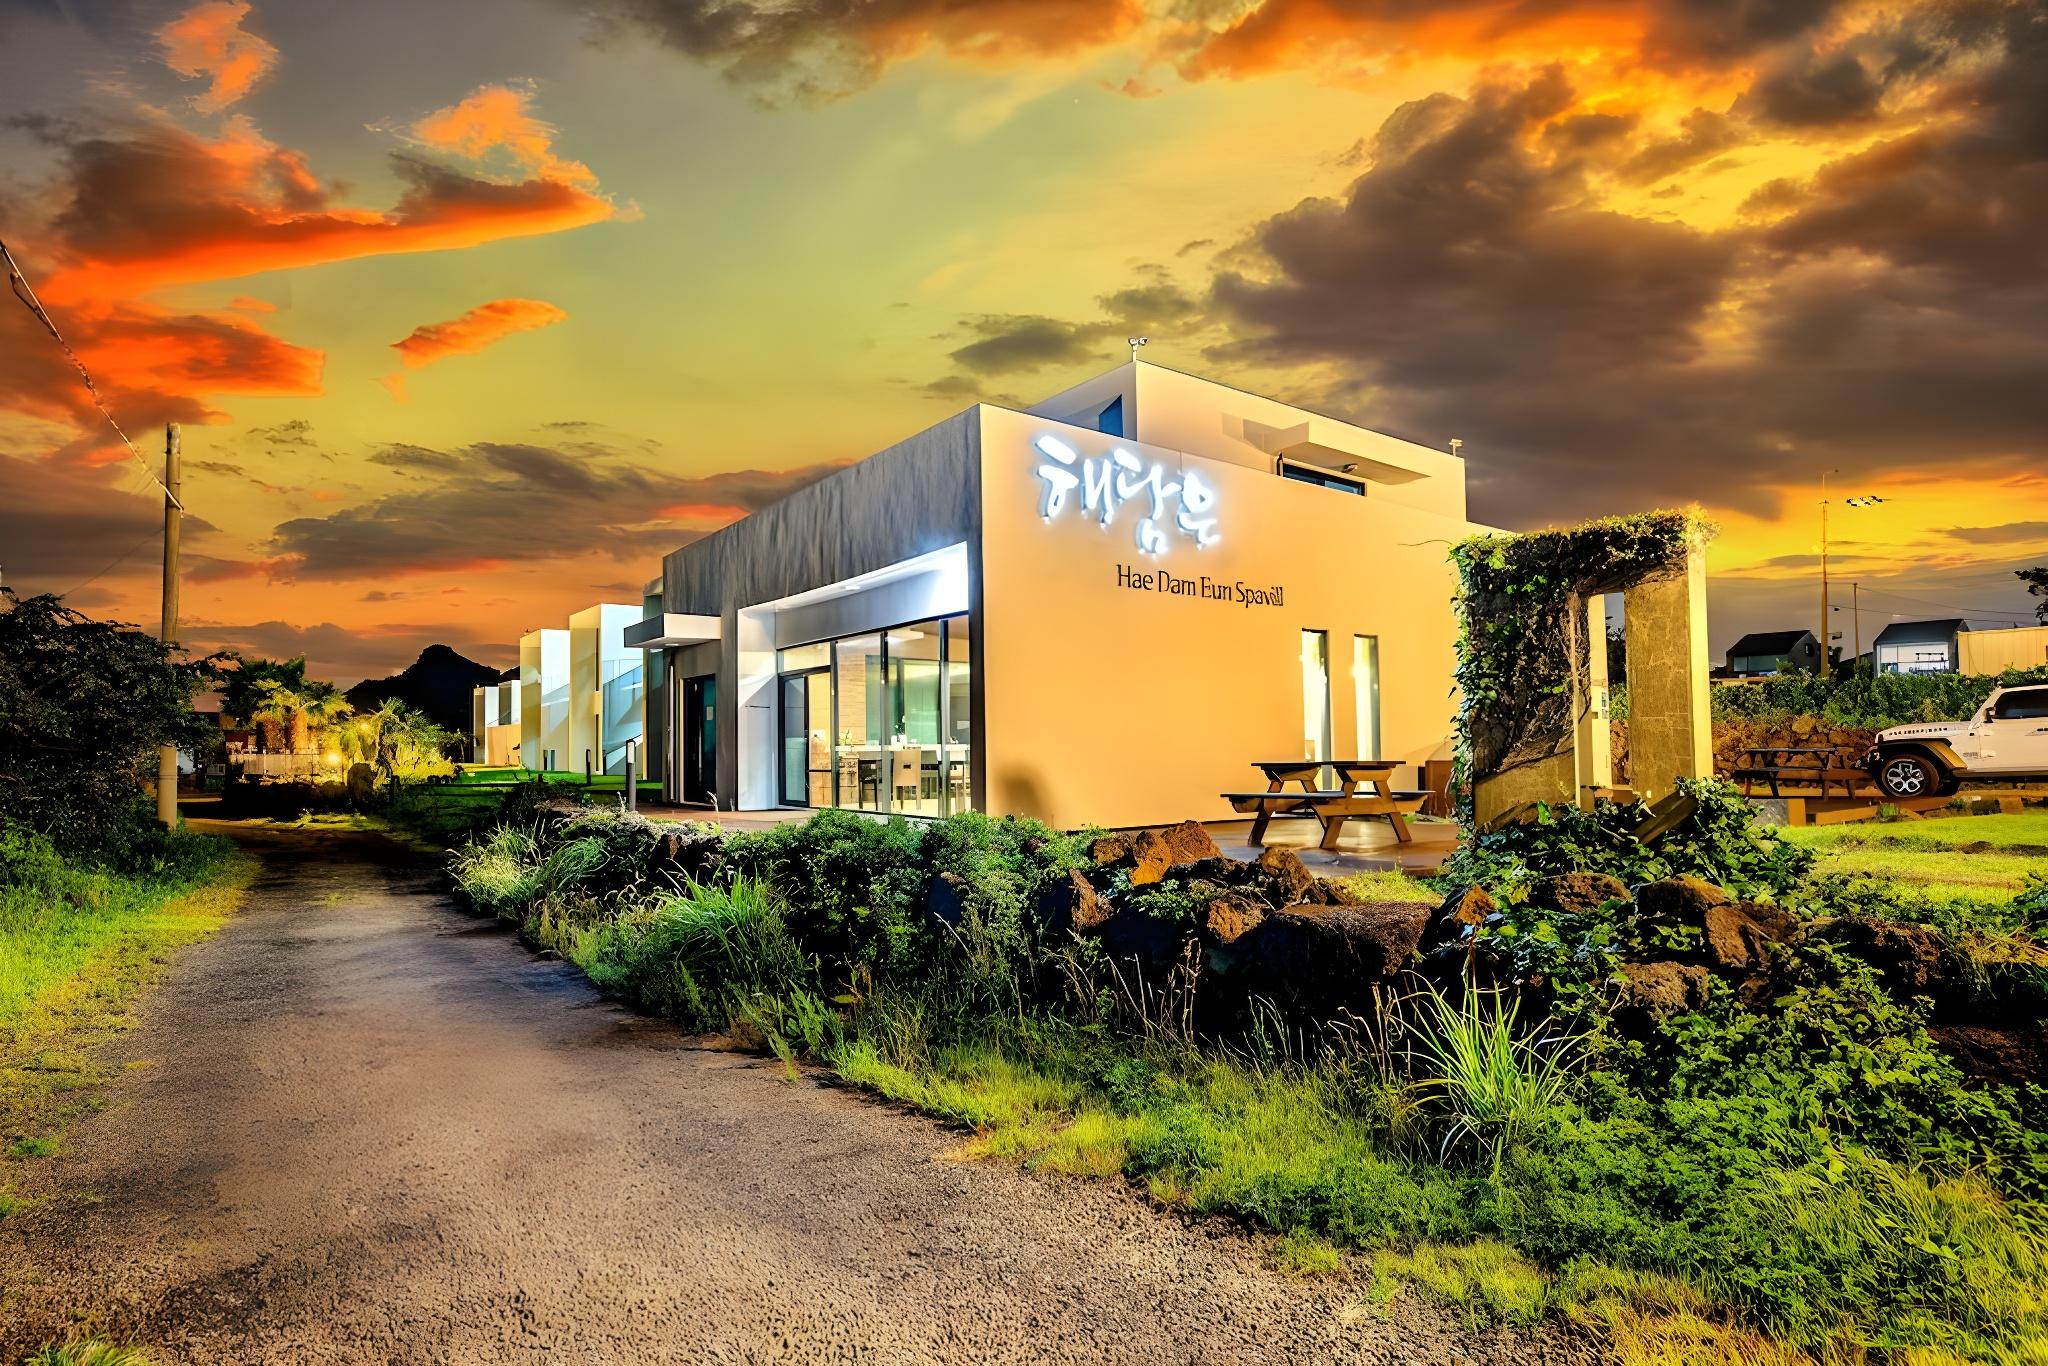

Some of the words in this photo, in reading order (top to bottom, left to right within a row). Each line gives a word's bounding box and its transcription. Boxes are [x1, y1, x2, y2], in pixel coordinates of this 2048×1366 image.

[1035, 435, 1221, 553] 해담은
[1116, 564, 1154, 591] Hae
[1157, 570, 1196, 596] Dam
[1200, 576, 1232, 601] Eun
